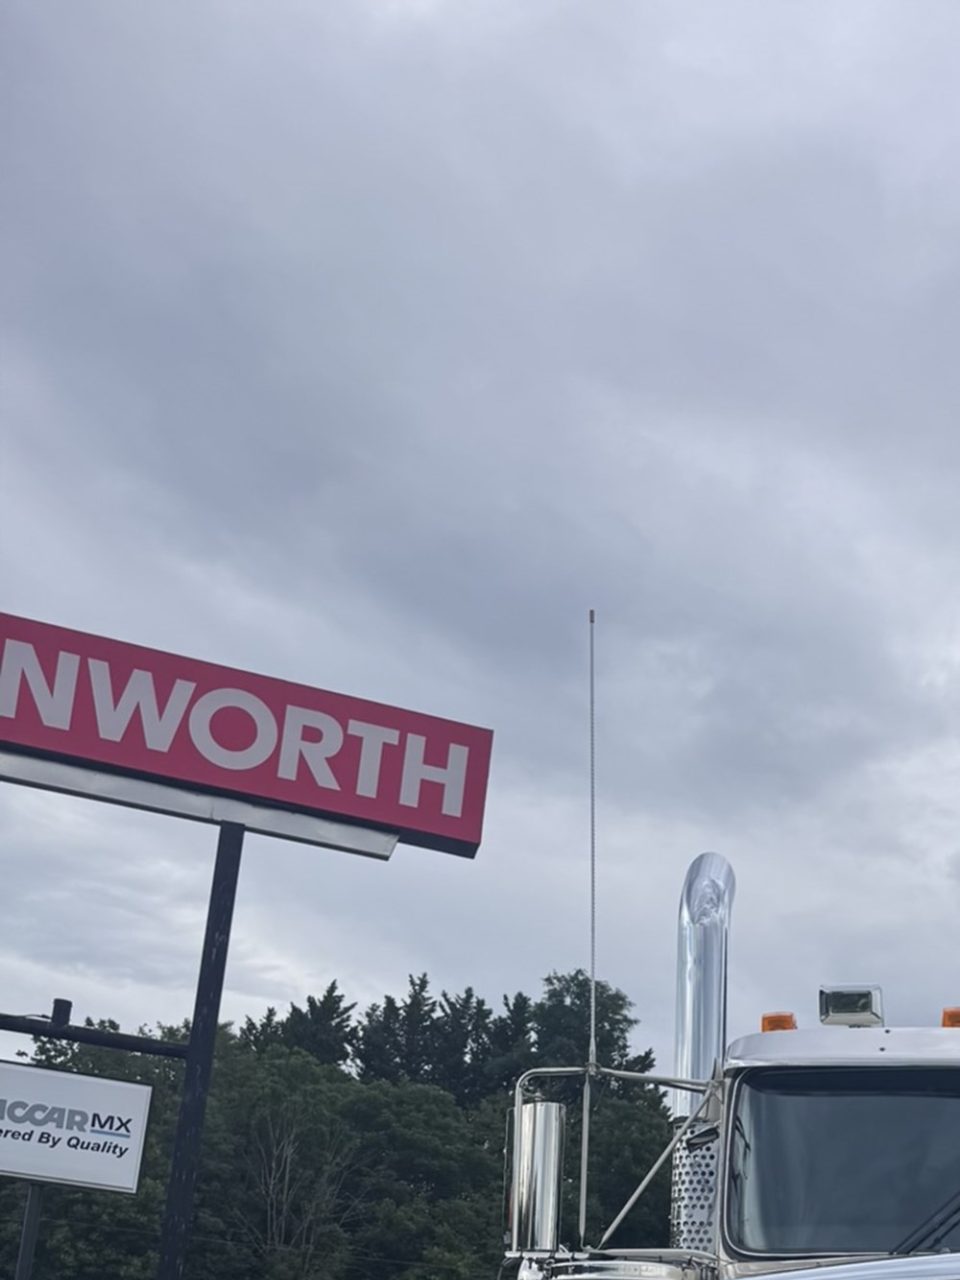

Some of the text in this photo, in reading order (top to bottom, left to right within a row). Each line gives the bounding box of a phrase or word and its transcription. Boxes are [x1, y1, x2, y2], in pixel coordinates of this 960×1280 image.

[0, 638, 470, 819] NWORTH
[90, 1113, 132, 1133] MX
[38, 1131, 62, 1148] By
[67, 1136, 129, 1158] Quality
